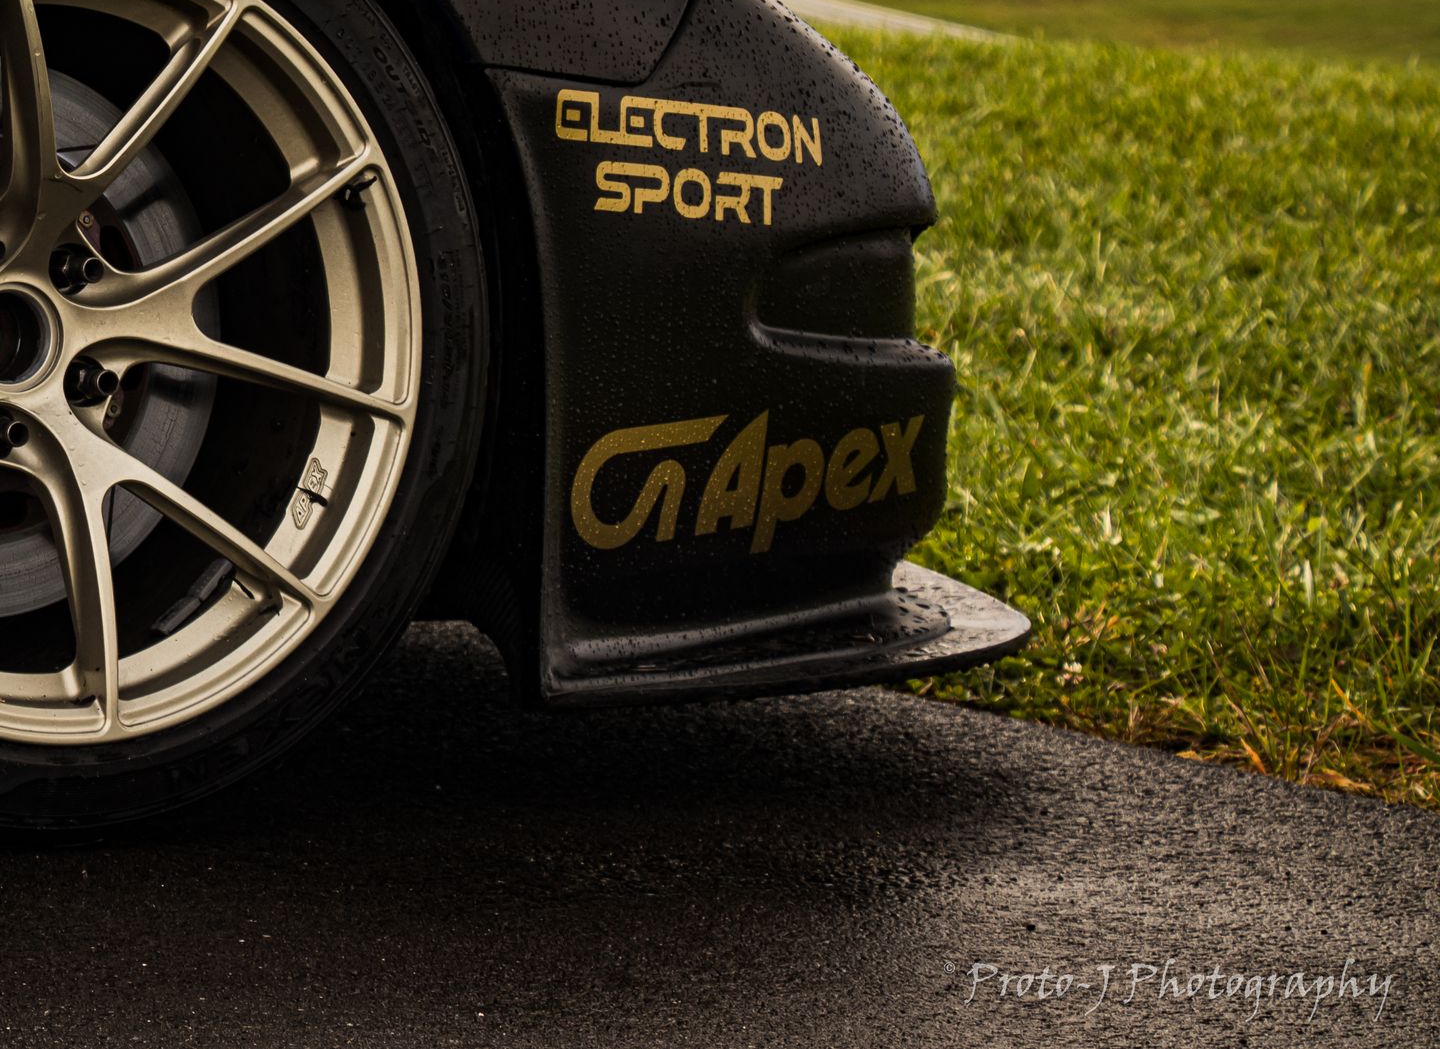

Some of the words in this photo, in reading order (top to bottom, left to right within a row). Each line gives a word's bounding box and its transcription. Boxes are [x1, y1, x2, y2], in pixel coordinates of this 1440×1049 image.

[555, 88, 823, 167] ELECTRON
[594, 159, 784, 226] SPORT
[695, 408, 926, 554] Apex
